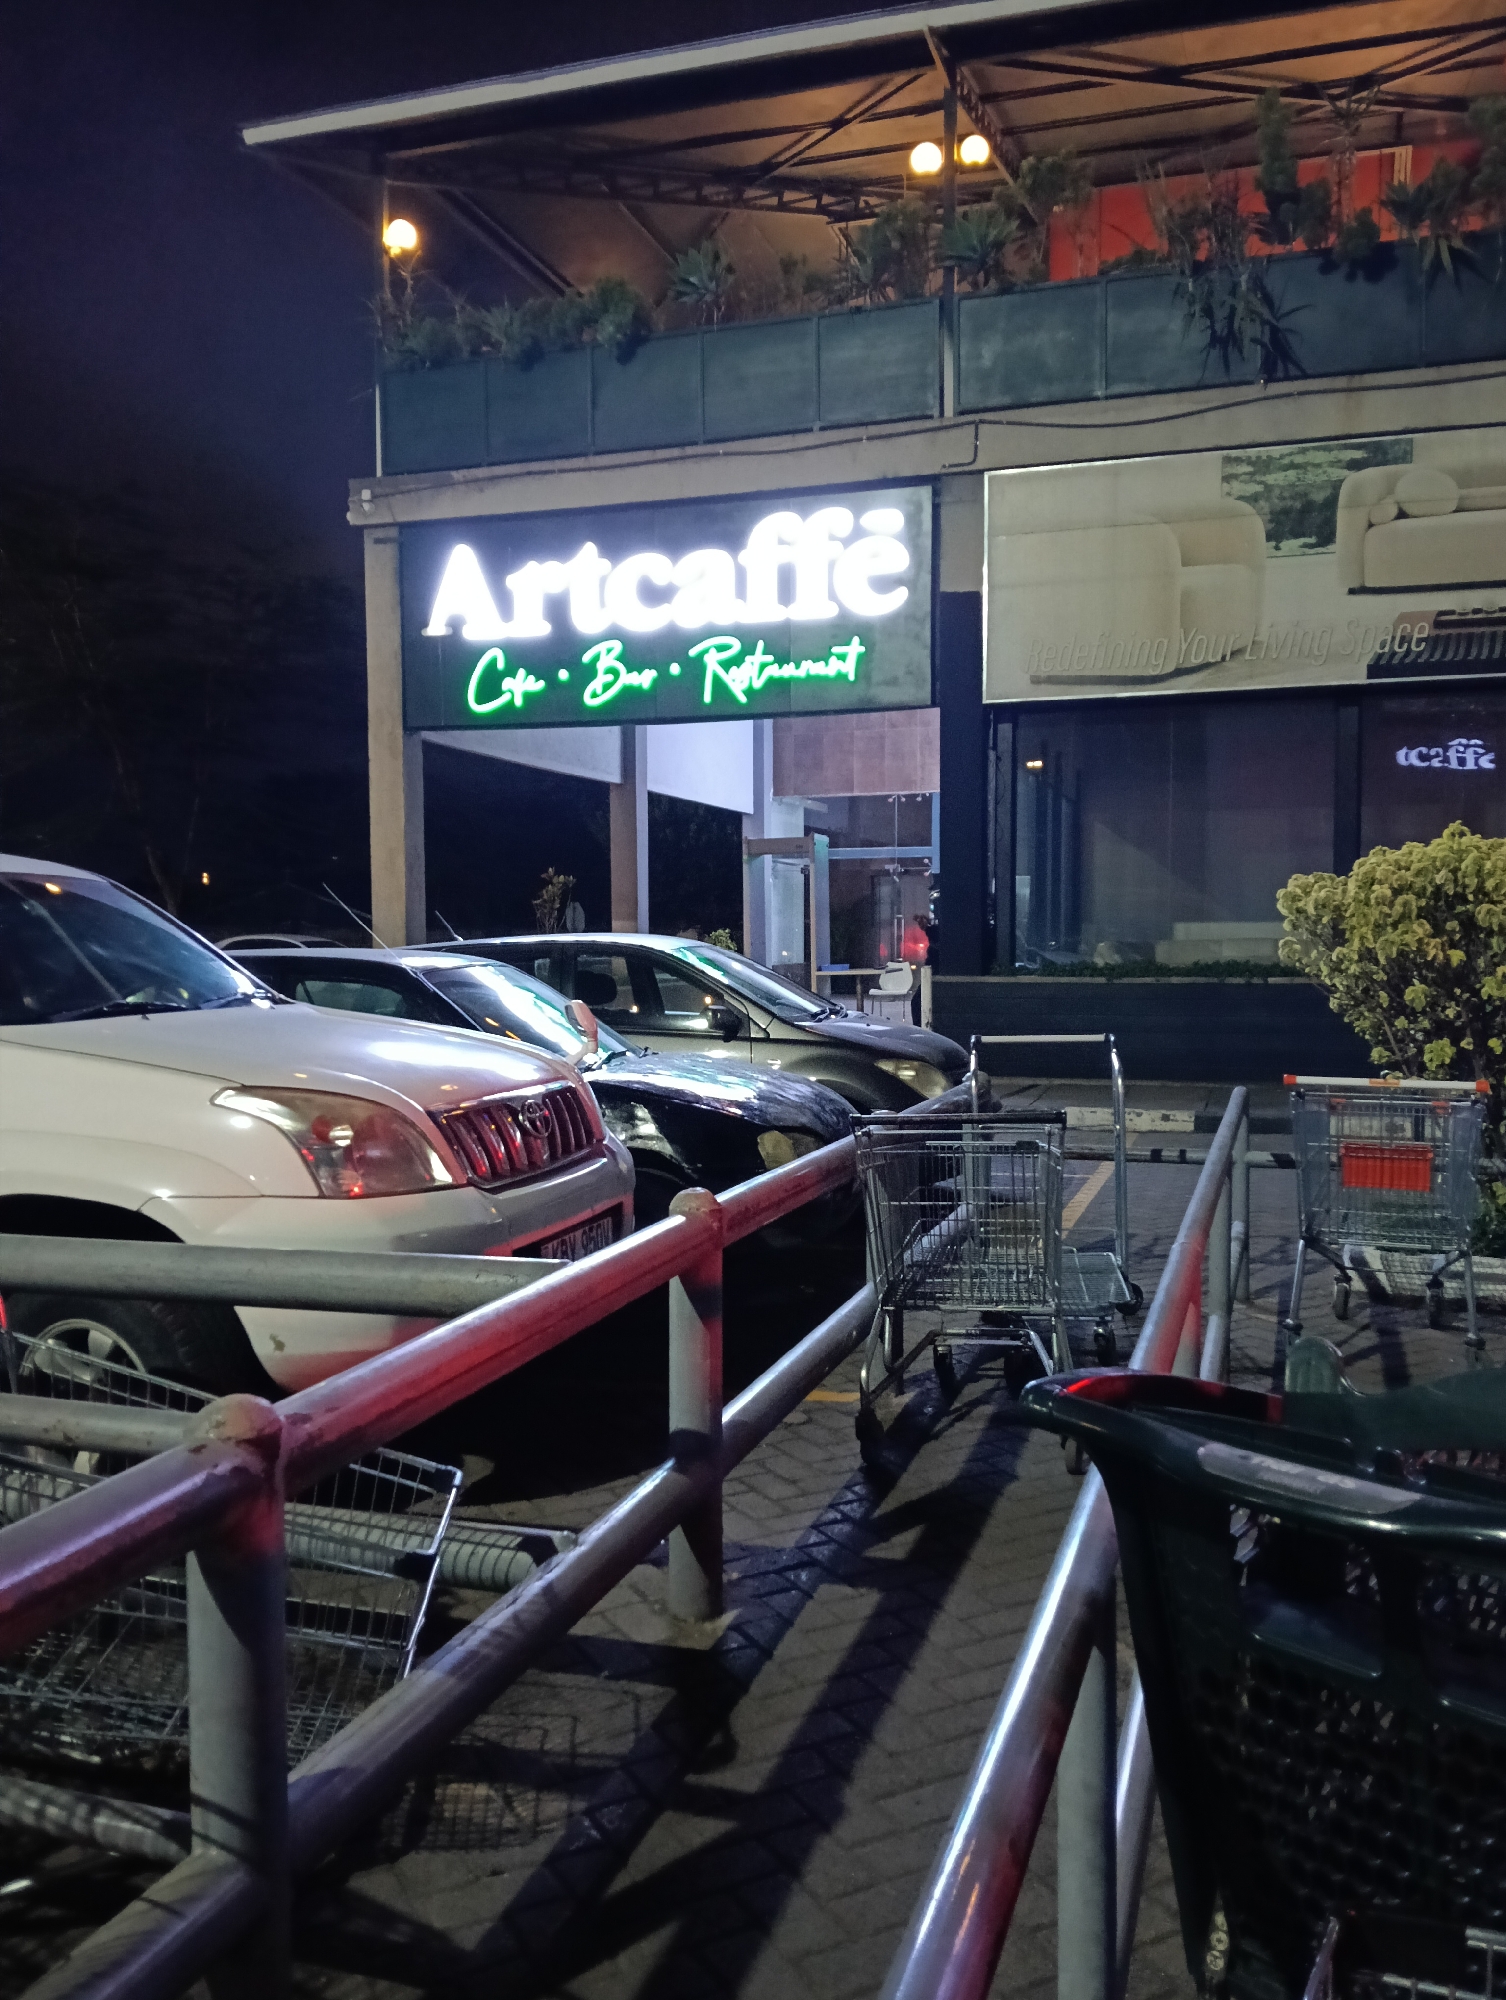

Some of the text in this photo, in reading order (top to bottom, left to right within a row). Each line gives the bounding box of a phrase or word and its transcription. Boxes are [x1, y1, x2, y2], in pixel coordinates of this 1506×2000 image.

[1024, 617, 1430, 675] Redefining Your Living Space
